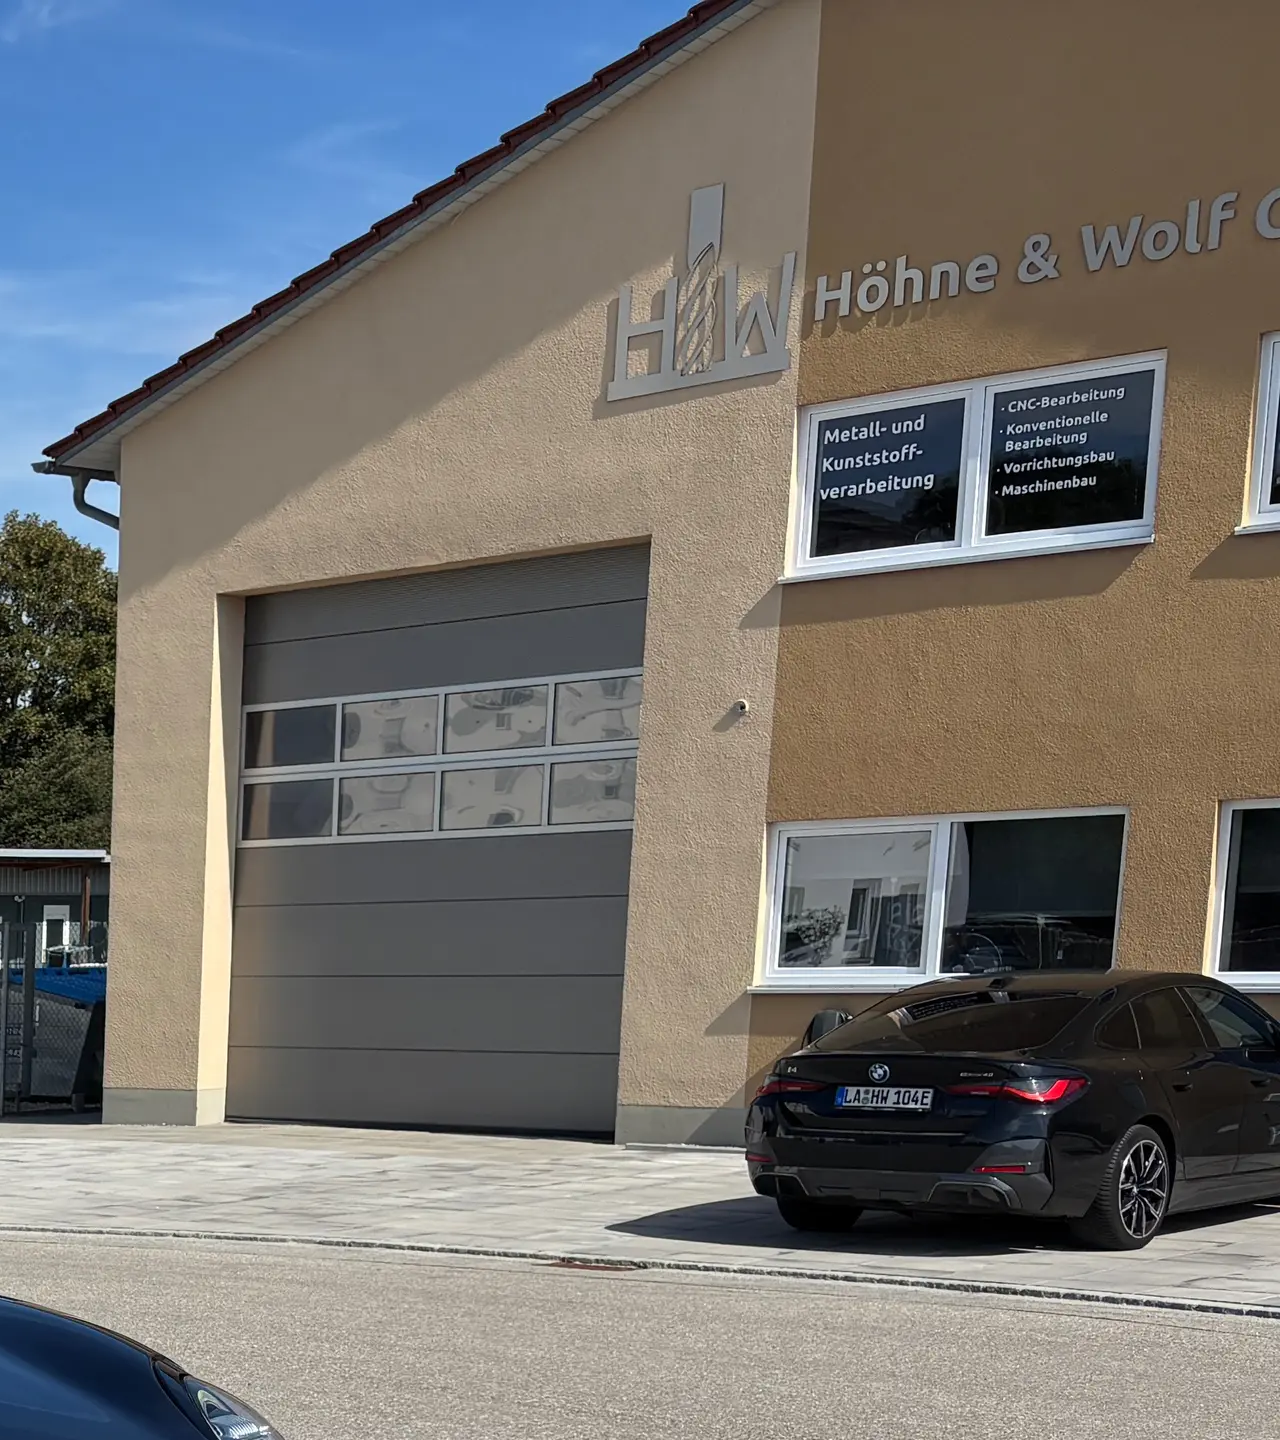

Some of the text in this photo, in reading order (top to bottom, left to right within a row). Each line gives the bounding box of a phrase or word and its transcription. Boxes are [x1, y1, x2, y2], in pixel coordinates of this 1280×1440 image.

[814, 253, 999, 322] Höhne
[1017, 232, 1061, 284] &
[1080, 191, 1239, 273] Wolf
[1007, 387, 1126, 413] CNC-Bearbeitung
[823, 413, 925, 445] Metall- und
[1006, 410, 1109, 436] Konventionelle
[1005, 431, 1088, 452] Bearbeitung
[822, 443, 924, 473] Kunststoff-
[1003, 450, 1116, 474] Vorrichtungsbau
[820, 473, 935, 500] verarbeitung
[1000, 475, 1098, 497] Maschinenbau
[844, 1088, 931, 1106] LA HW 104E
